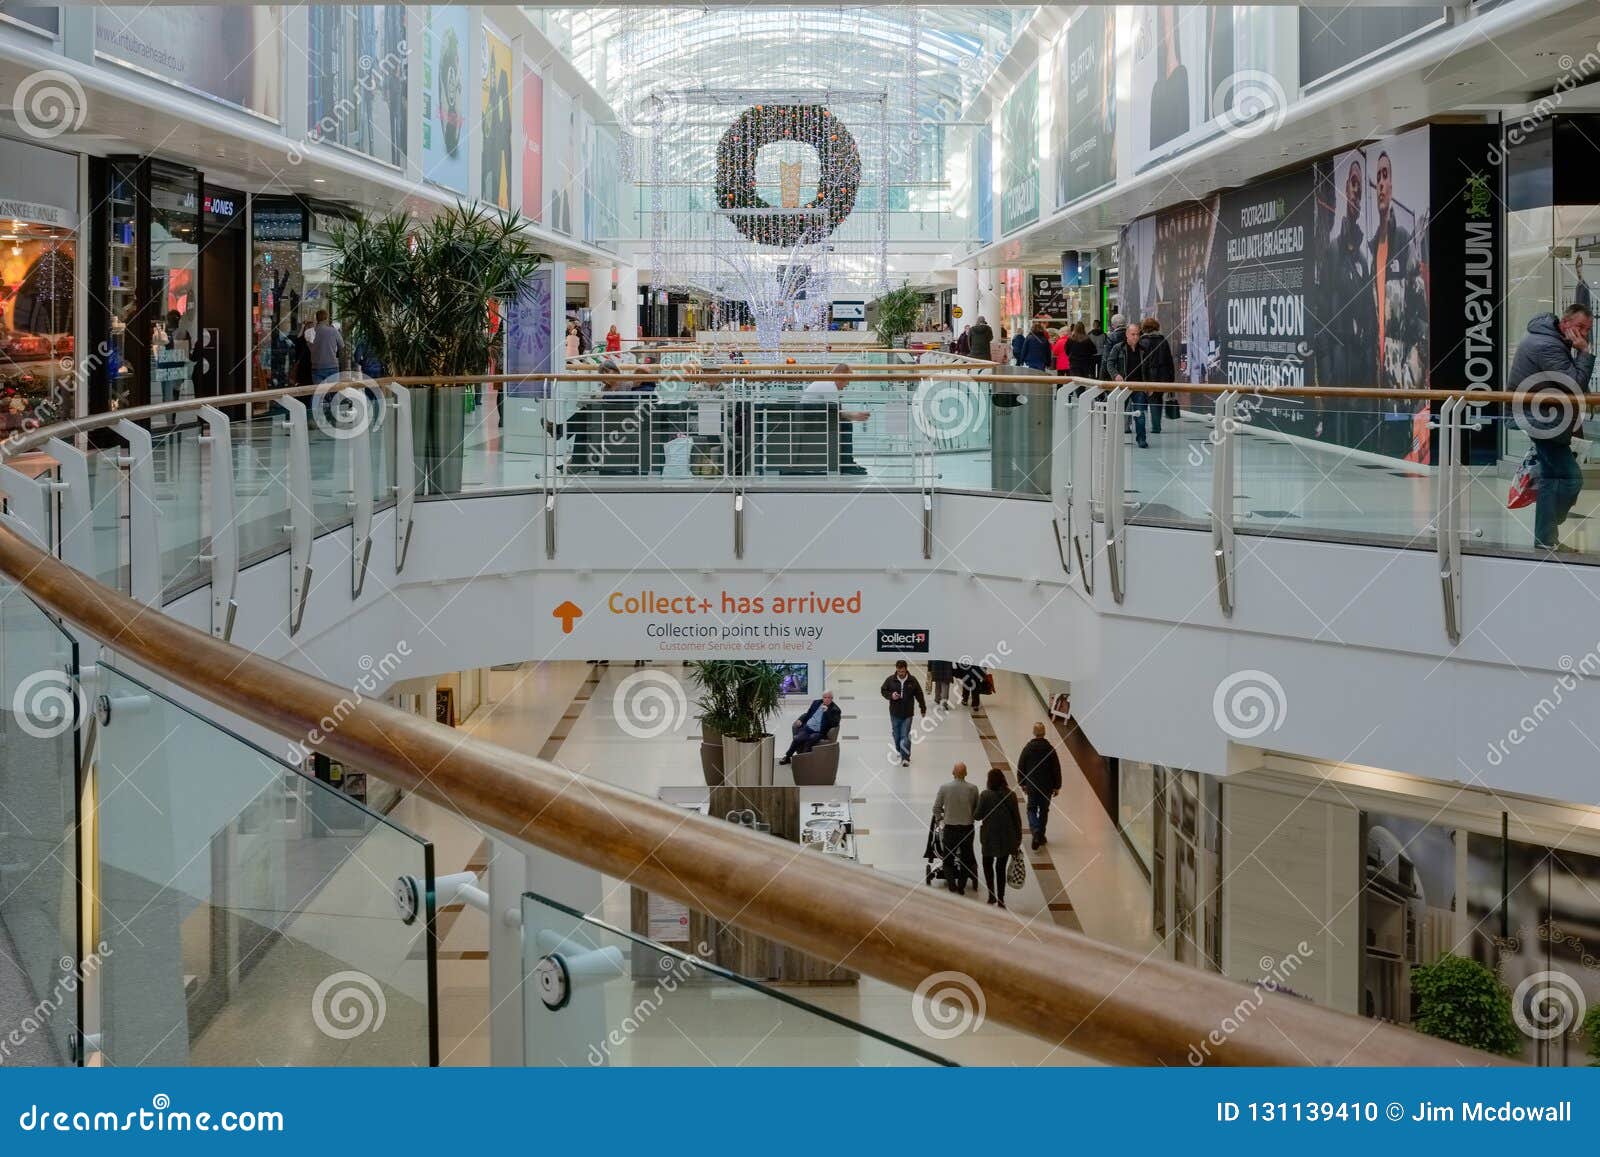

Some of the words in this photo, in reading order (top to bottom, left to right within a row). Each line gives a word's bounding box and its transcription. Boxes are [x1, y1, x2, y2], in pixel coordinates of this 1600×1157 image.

[211, 198, 233, 216] JONES
[1227, 237, 1247, 262] HELLO
[1263, 225, 1304, 257] BRAEHEAD
[1227, 296, 1267, 335] COMING
[1270, 294, 1304, 336] SOON
[608, 590, 713, 614] Collect+
[722, 590, 764, 614] has
[772, 590, 862, 614] arrived
[647, 623, 717, 637] Collection
[722, 623, 760, 640] point
[764, 623, 790, 637] this
[795, 626, 823, 639] way
[659, 641, 705, 651] Customer
[708, 641, 741, 651] Service
[743, 641, 767, 650] desk
[783, 641, 804, 650] level
[806, 641, 814, 650] 2
